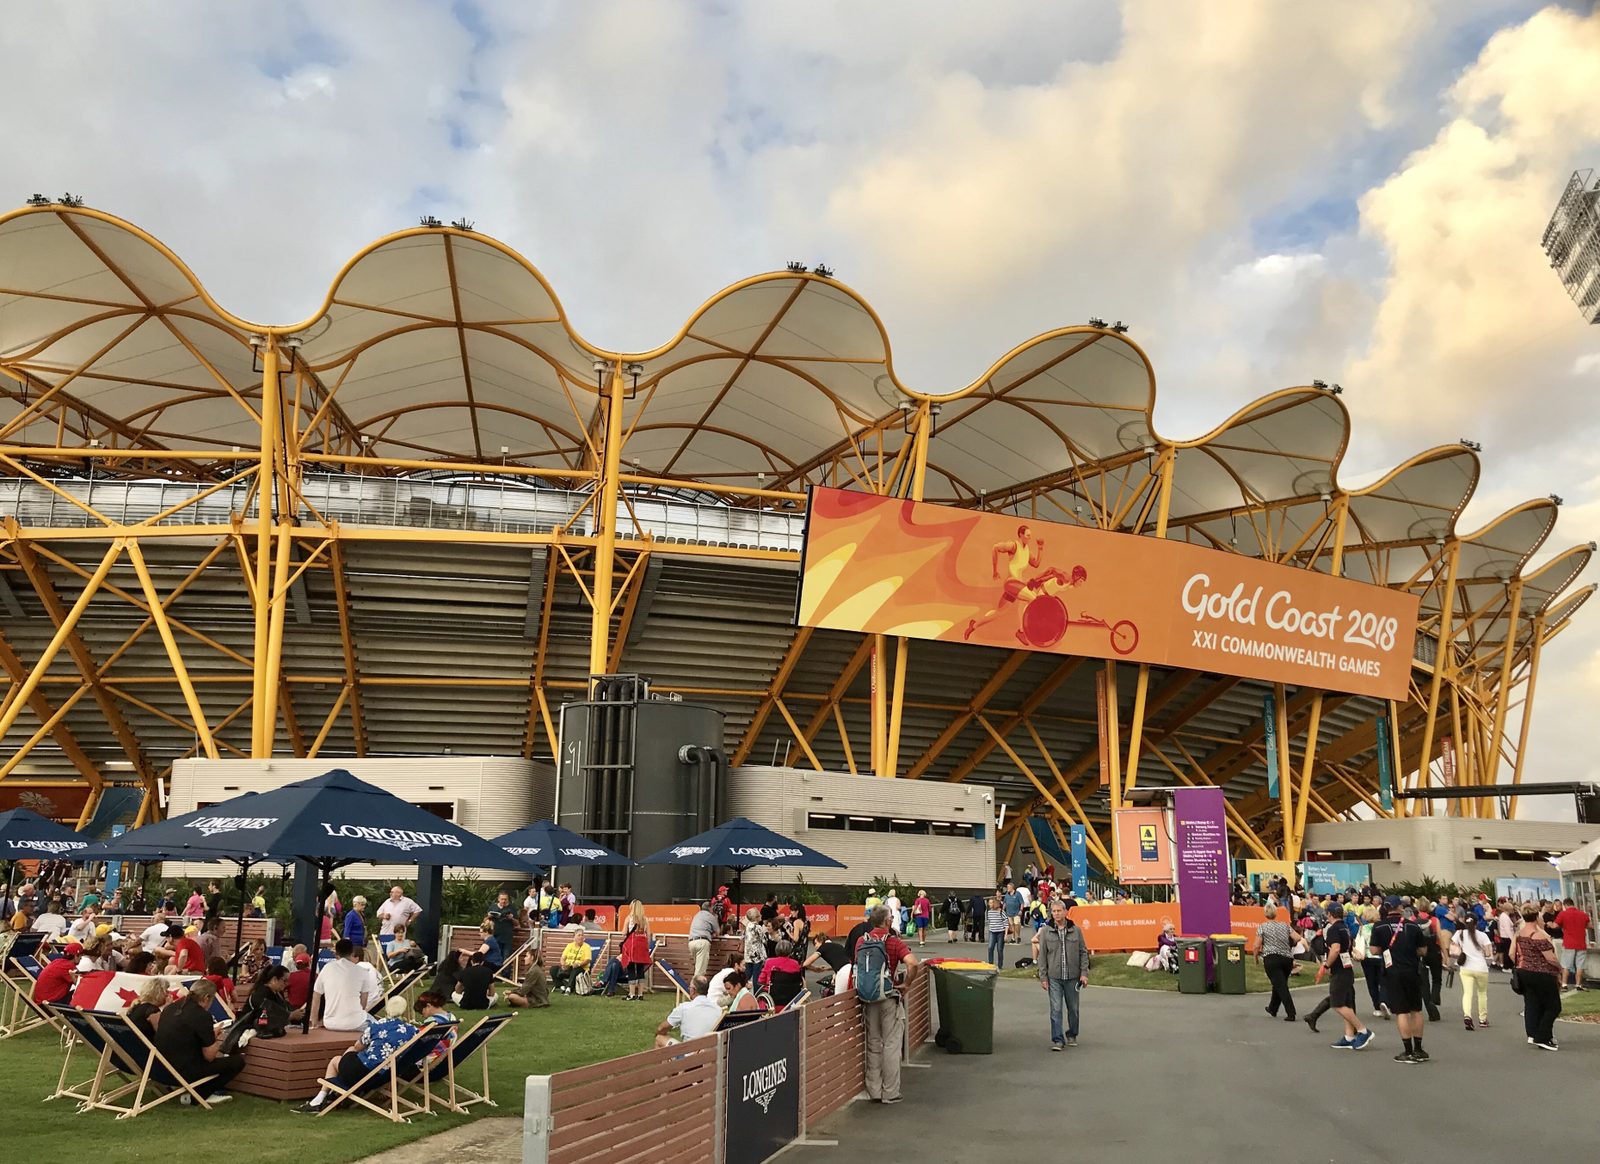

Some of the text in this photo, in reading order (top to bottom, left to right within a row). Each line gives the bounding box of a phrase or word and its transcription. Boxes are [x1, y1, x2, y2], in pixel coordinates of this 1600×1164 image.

[1182, 574, 1398, 652] Gold Coast 2018
[1192, 630, 1380, 678] XXI COMMONWEALTH GAMES
[184, 816, 279, 829] LONGINES
[320, 822, 463, 847] LONGINES
[1075, 833, 1082, 844] J
[7, 840, 88, 850] LONGINES
[729, 847, 804, 856] LONGINES
[742, 1058, 787, 1102] LONGINES
